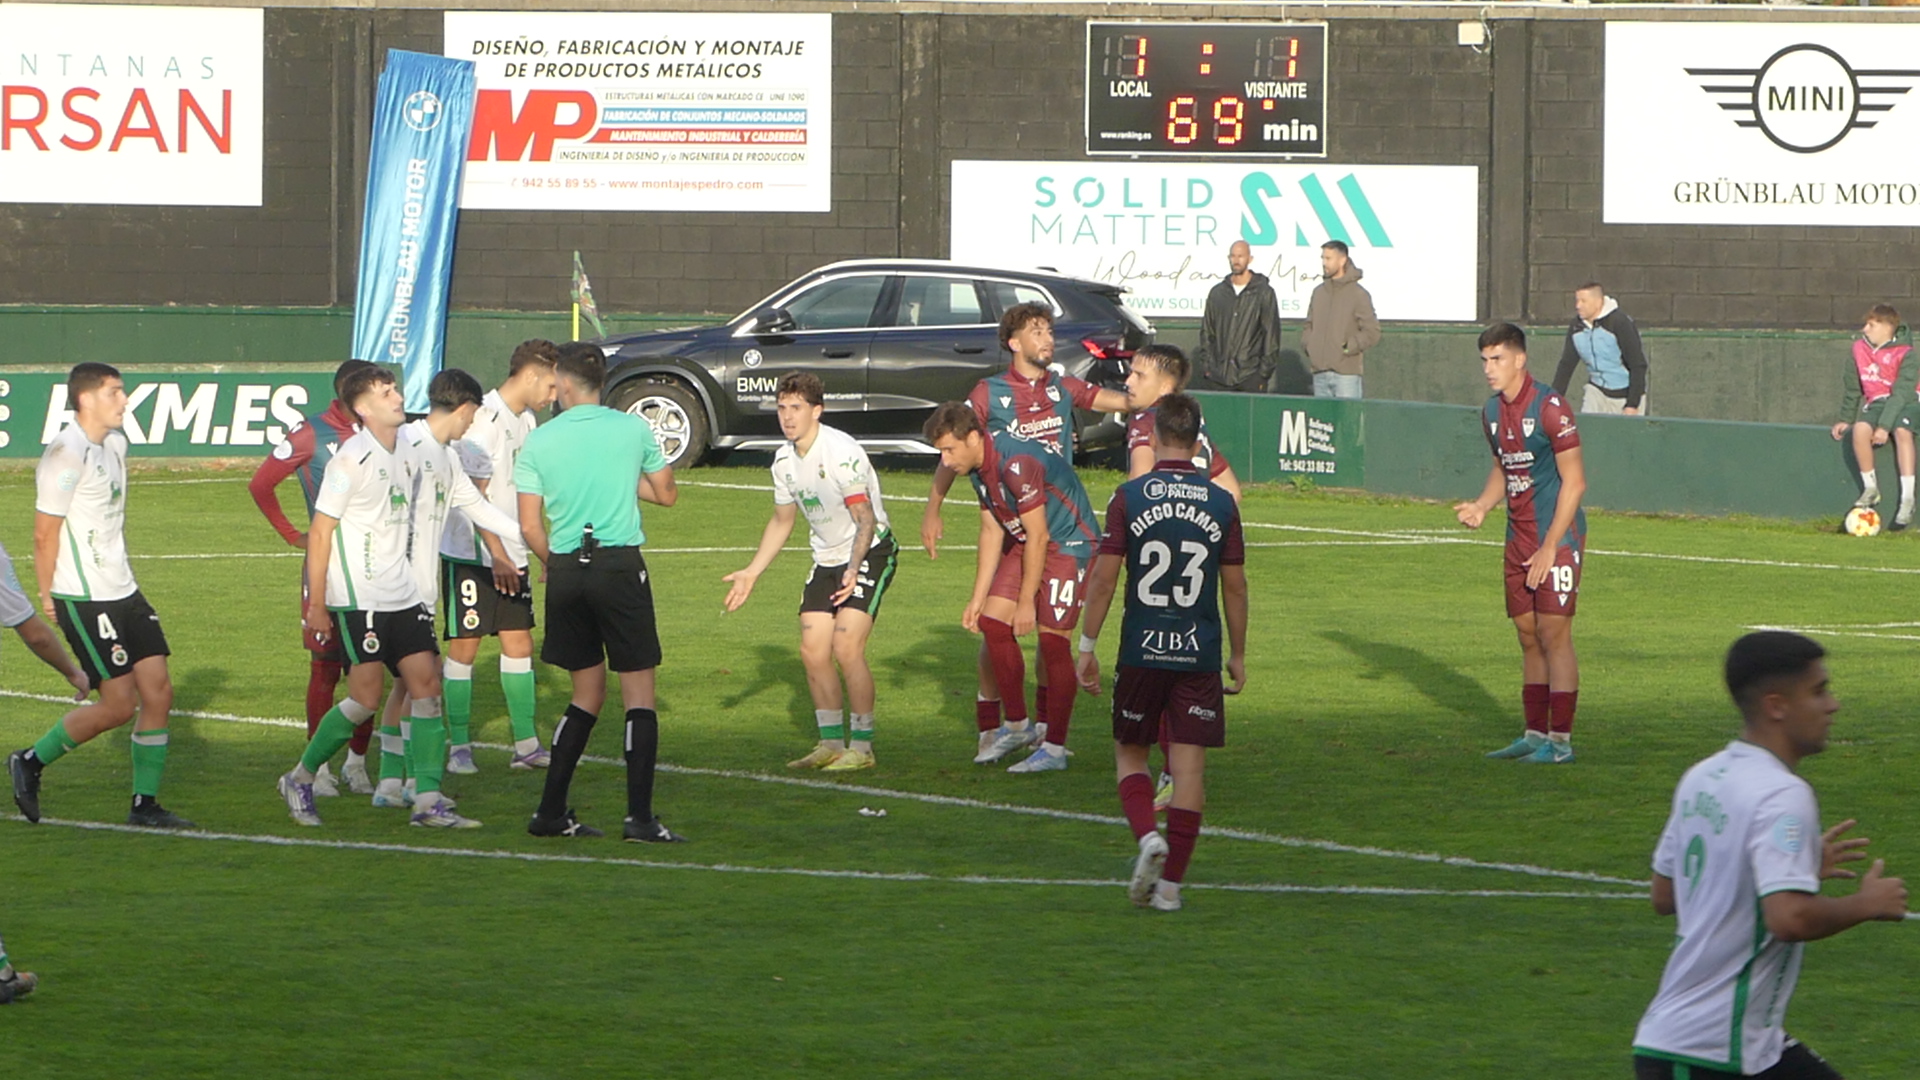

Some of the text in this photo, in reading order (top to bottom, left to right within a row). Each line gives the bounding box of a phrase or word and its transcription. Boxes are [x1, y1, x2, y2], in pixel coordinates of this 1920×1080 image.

[472, 35, 804, 57] DISEÑO, FABRICACIÓN Y MONTAJE
[504, 57, 762, 78] DE PRODUCTOS METÁLICOS
[605, 92, 654, 101] ESTRUCTURAS
[716, 92, 754, 101] MARCADO
[1110, 81, 1307, 98] LOCAL VISITANTE
[1768, 86, 1844, 111] MINI
[467, 89, 598, 161] MP
[610, 130, 687, 142] MANTENIMIENTO
[688, 131, 741, 142] INDUSTRIAL
[742, 131, 751, 142] Y
[1263, 119, 1318, 141] min
[522, 177, 543, 188] 942
[547, 178, 561, 188] 55
[565, 178, 579, 188] 89
[583, 178, 597, 188] 55
[1035, 176, 1213, 208] SOLID
[1674, 176, 1920, 206] GRÜNBLAU MOTO
[402, 157, 428, 237] MOTOR
[1031, 213, 1217, 246] MATTER
[737, 377, 778, 392] BMW
[1168, 489, 1208, 502] PALOMO
[1130, 502, 1222, 542] DIEGO CAMPO
[1137, 540, 1209, 607] 23
[1550, 565, 1573, 592] 19
[461, 579, 478, 606] 9
[1049, 578, 1074, 607] 14
[97, 613, 117, 640] 4
[1141, 621, 1199, 654] ZIBÁ
